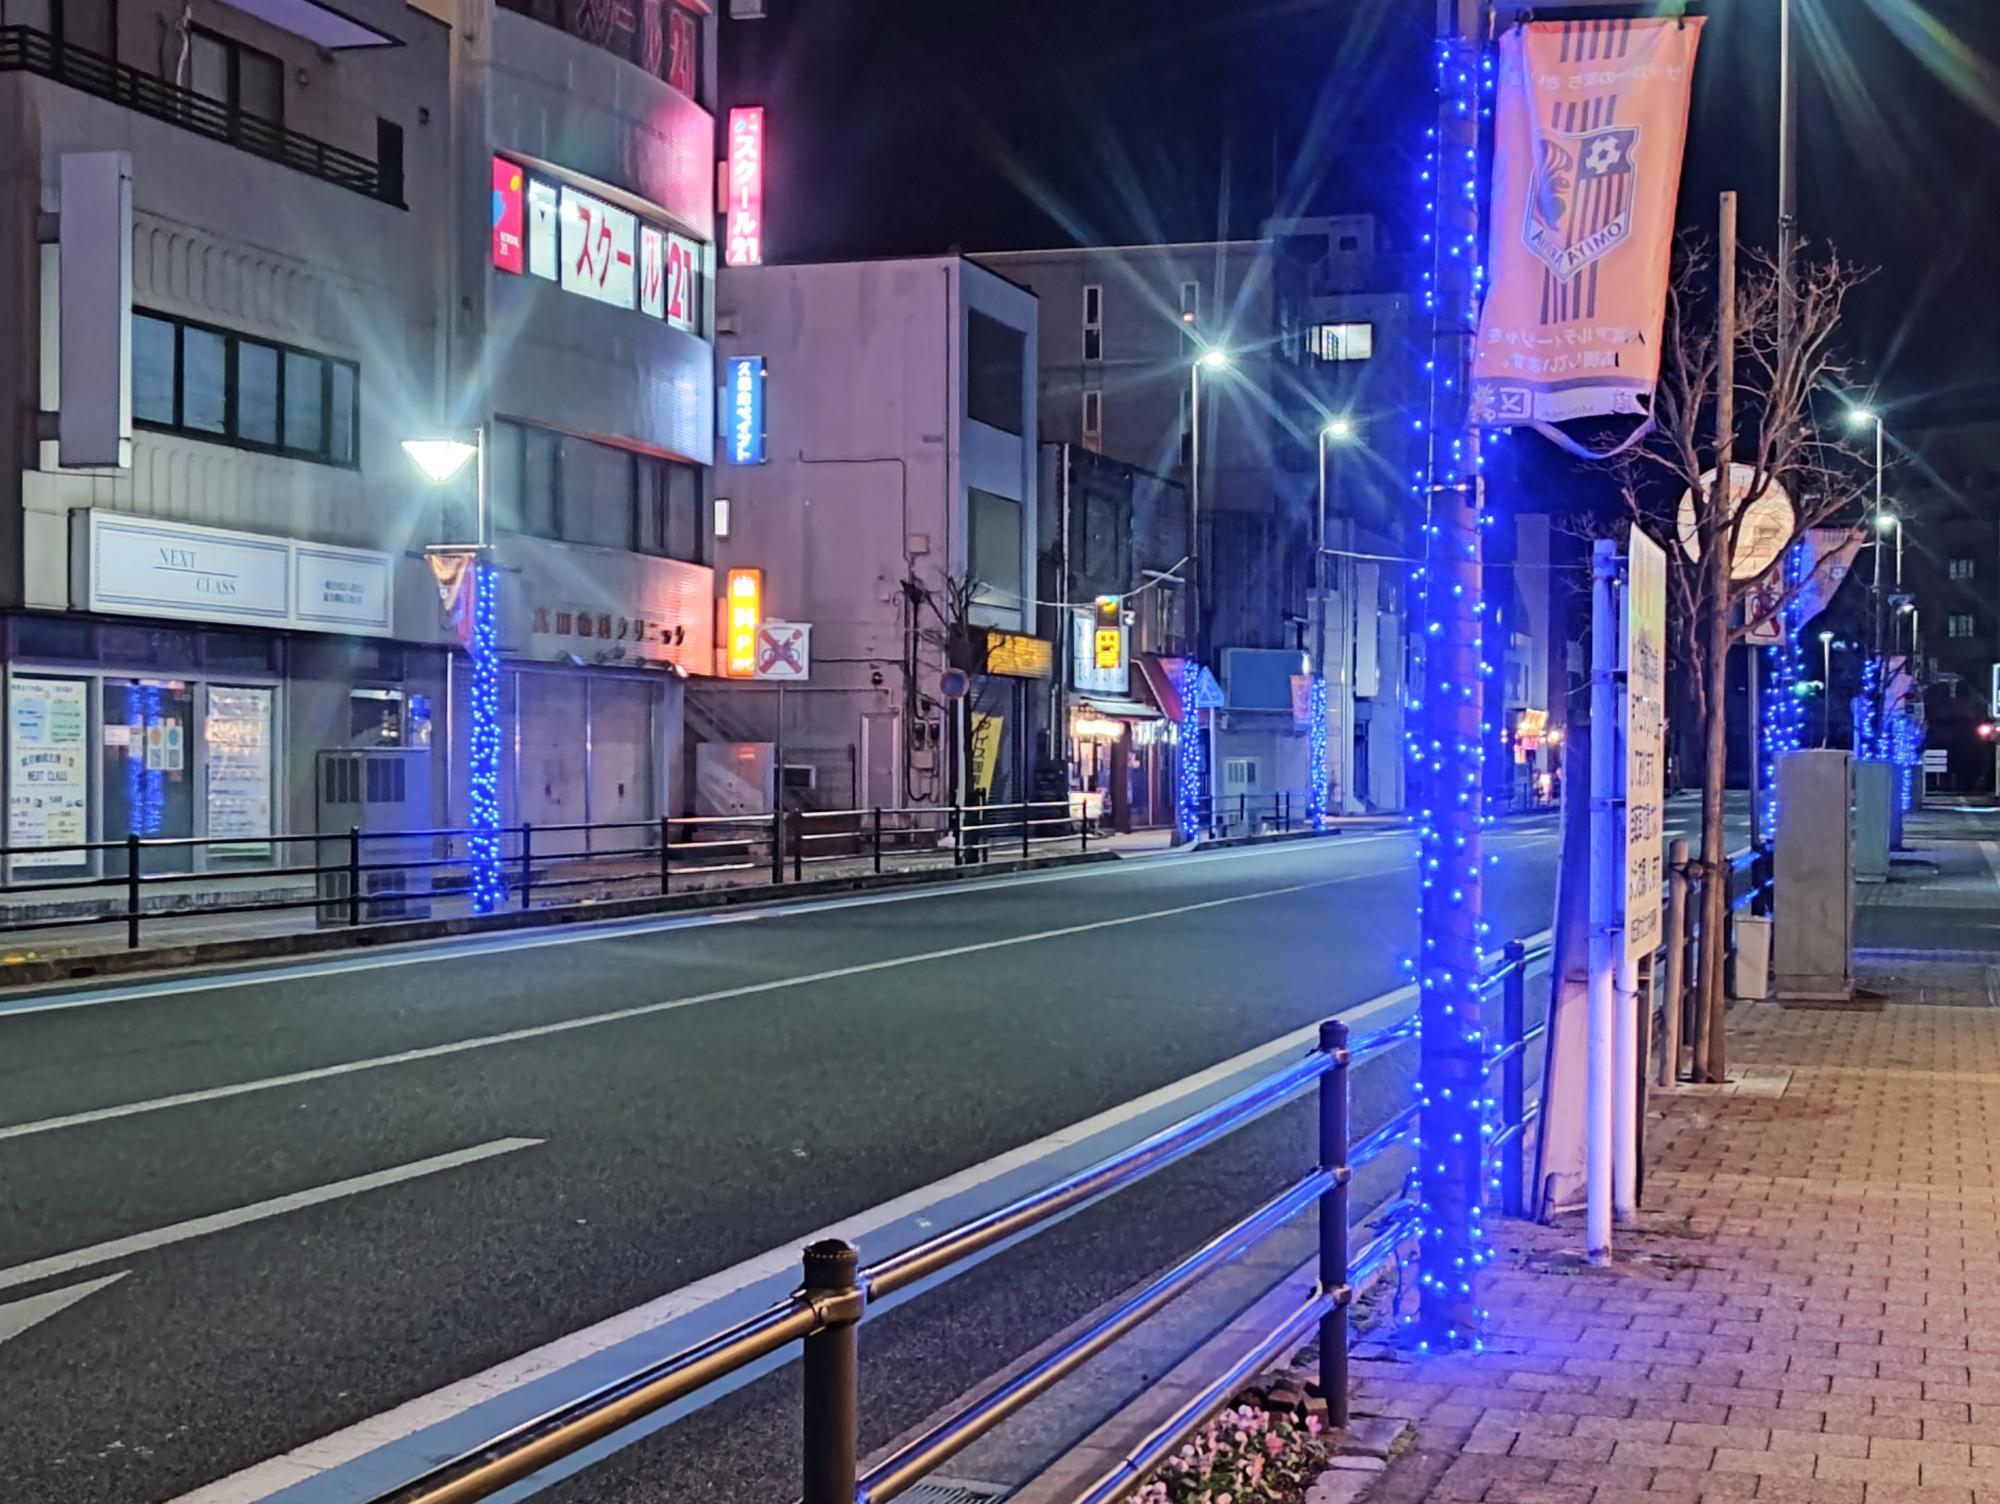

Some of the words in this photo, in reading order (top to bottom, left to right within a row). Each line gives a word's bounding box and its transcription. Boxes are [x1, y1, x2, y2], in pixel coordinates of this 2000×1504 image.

[731, 136, 758, 264] スクール21
[576, 202, 694, 322] スクール21
[158, 547, 198, 569] NEXT
[196, 577, 237, 596] CLASS
